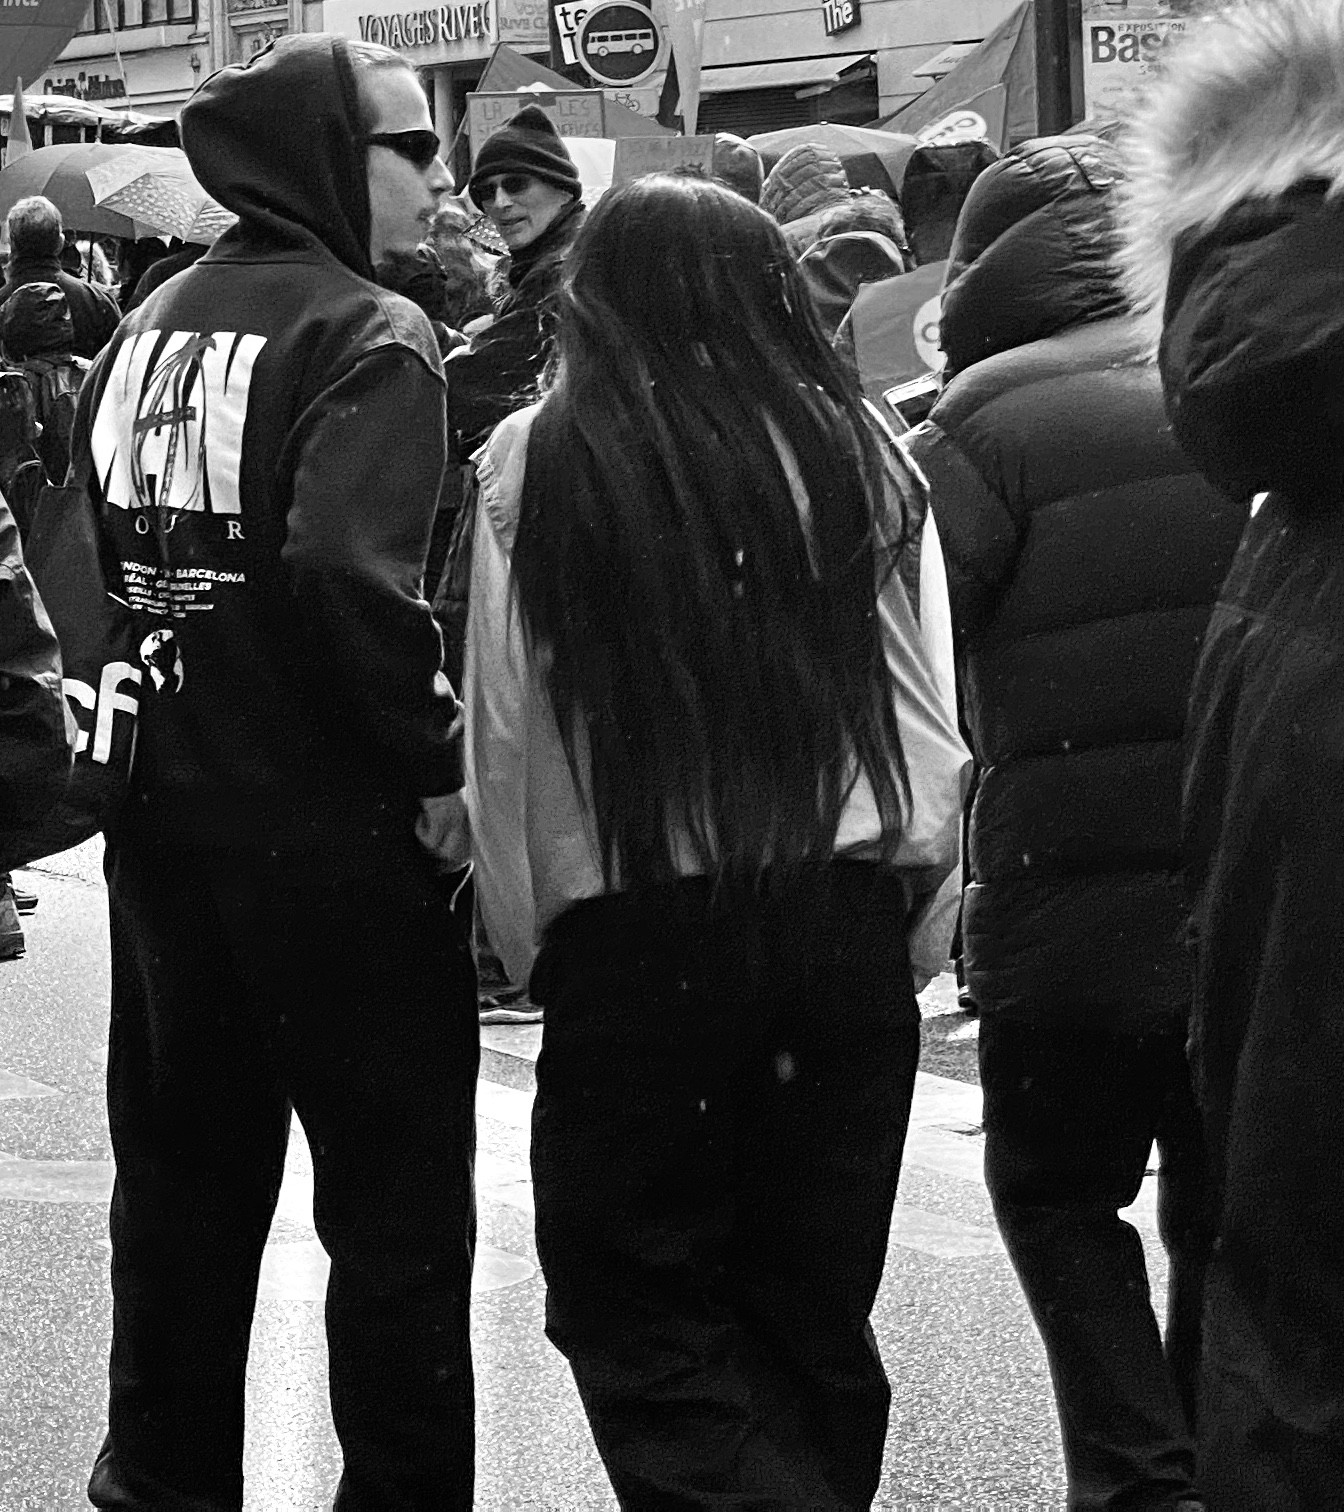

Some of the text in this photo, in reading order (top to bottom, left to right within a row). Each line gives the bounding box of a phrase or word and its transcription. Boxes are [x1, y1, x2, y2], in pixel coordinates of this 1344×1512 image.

[359, 10, 438, 48] VOYAGES
[438, 3, 482, 42] RIVE
[560, 7, 588, 31] te
